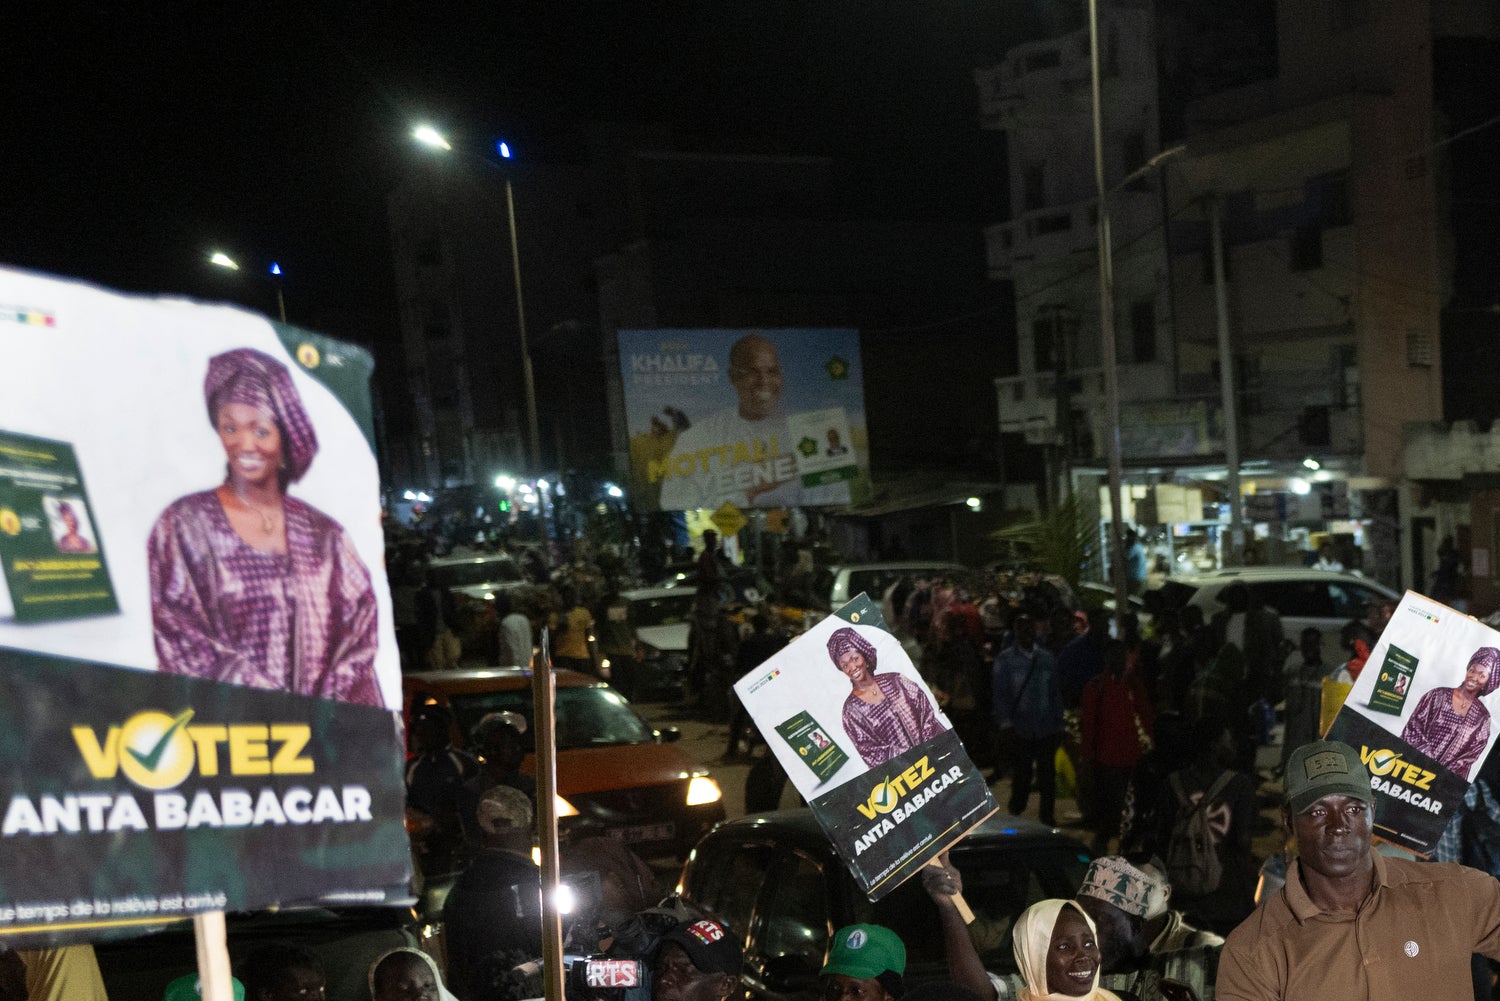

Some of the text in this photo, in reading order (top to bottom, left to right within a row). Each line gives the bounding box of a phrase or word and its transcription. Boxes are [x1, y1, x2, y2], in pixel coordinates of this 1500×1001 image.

[630, 353, 720, 371] KHALIFA
[646, 433, 779, 483] MOTTALI
[71, 709, 314, 790] VOTEZ
[1360, 745, 1437, 790] VOTEZ
[857, 755, 935, 820] VOTEZ
[1370, 775, 1443, 815] BABACAR
[2, 784, 373, 836] ANTA BABACAR
[854, 818, 895, 856] ANTA
[891, 765, 963, 824] BABACAR
[873, 867, 891, 883] temps
[887, 862, 896, 870] de
[911, 842, 921, 851] est
[16, 904, 69, 922] temps
[70, 900, 94, 916] de
[94, 898, 111, 914] la
[111, 895, 159, 913] relève
[160, 894, 183, 910] est
[695, 920, 725, 941] RTS
[591, 961, 634, 987] RTS
